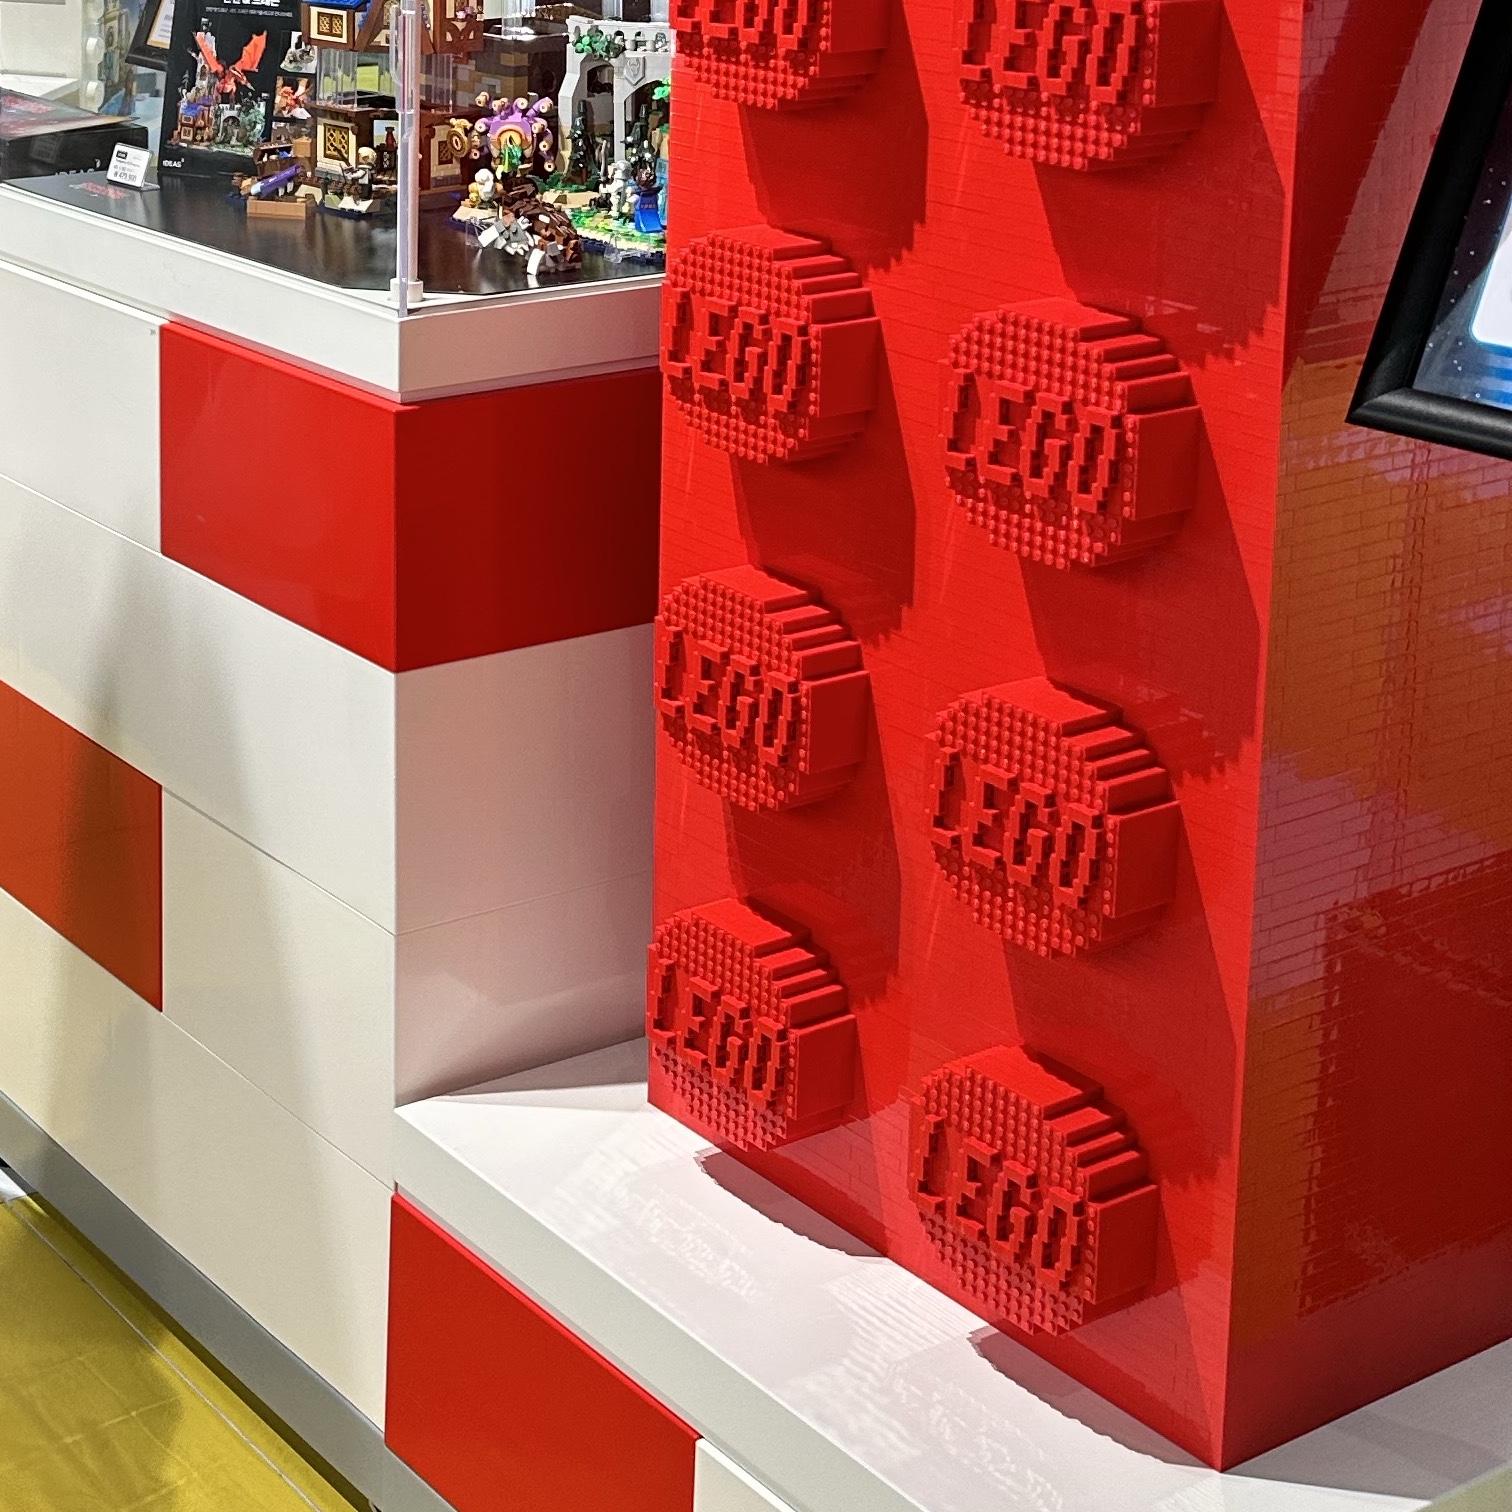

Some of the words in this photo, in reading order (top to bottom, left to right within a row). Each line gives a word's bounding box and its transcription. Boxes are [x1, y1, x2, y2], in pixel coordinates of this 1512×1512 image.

[162, 159, 182, 168] IDEAS
[662, 287, 813, 410] LEGO
[939, 368, 1126, 514] LEGO
[655, 624, 799, 765] LEGO
[927, 747, 1105, 908] LEGO
[647, 958, 787, 1110] LEGO
[909, 1113, 1084, 1290] LEGO
